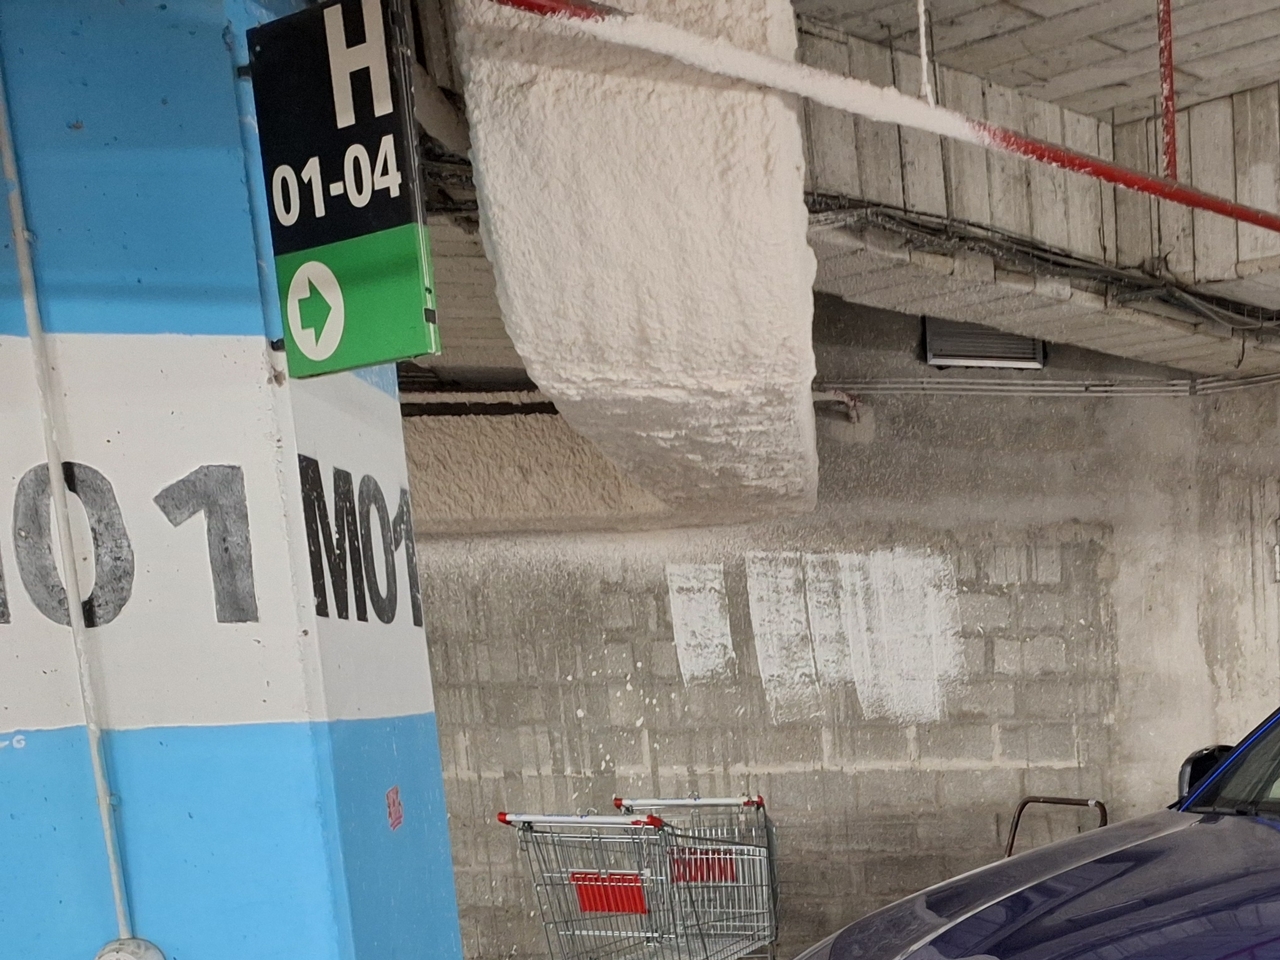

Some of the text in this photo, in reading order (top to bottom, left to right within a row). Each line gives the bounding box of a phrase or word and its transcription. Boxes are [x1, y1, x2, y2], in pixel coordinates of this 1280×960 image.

[323, 0, 394, 130] H
[272, 134, 403, 227] 01-04
[0, 461, 259, 628] 01
[297, 453, 423, 627] M01
